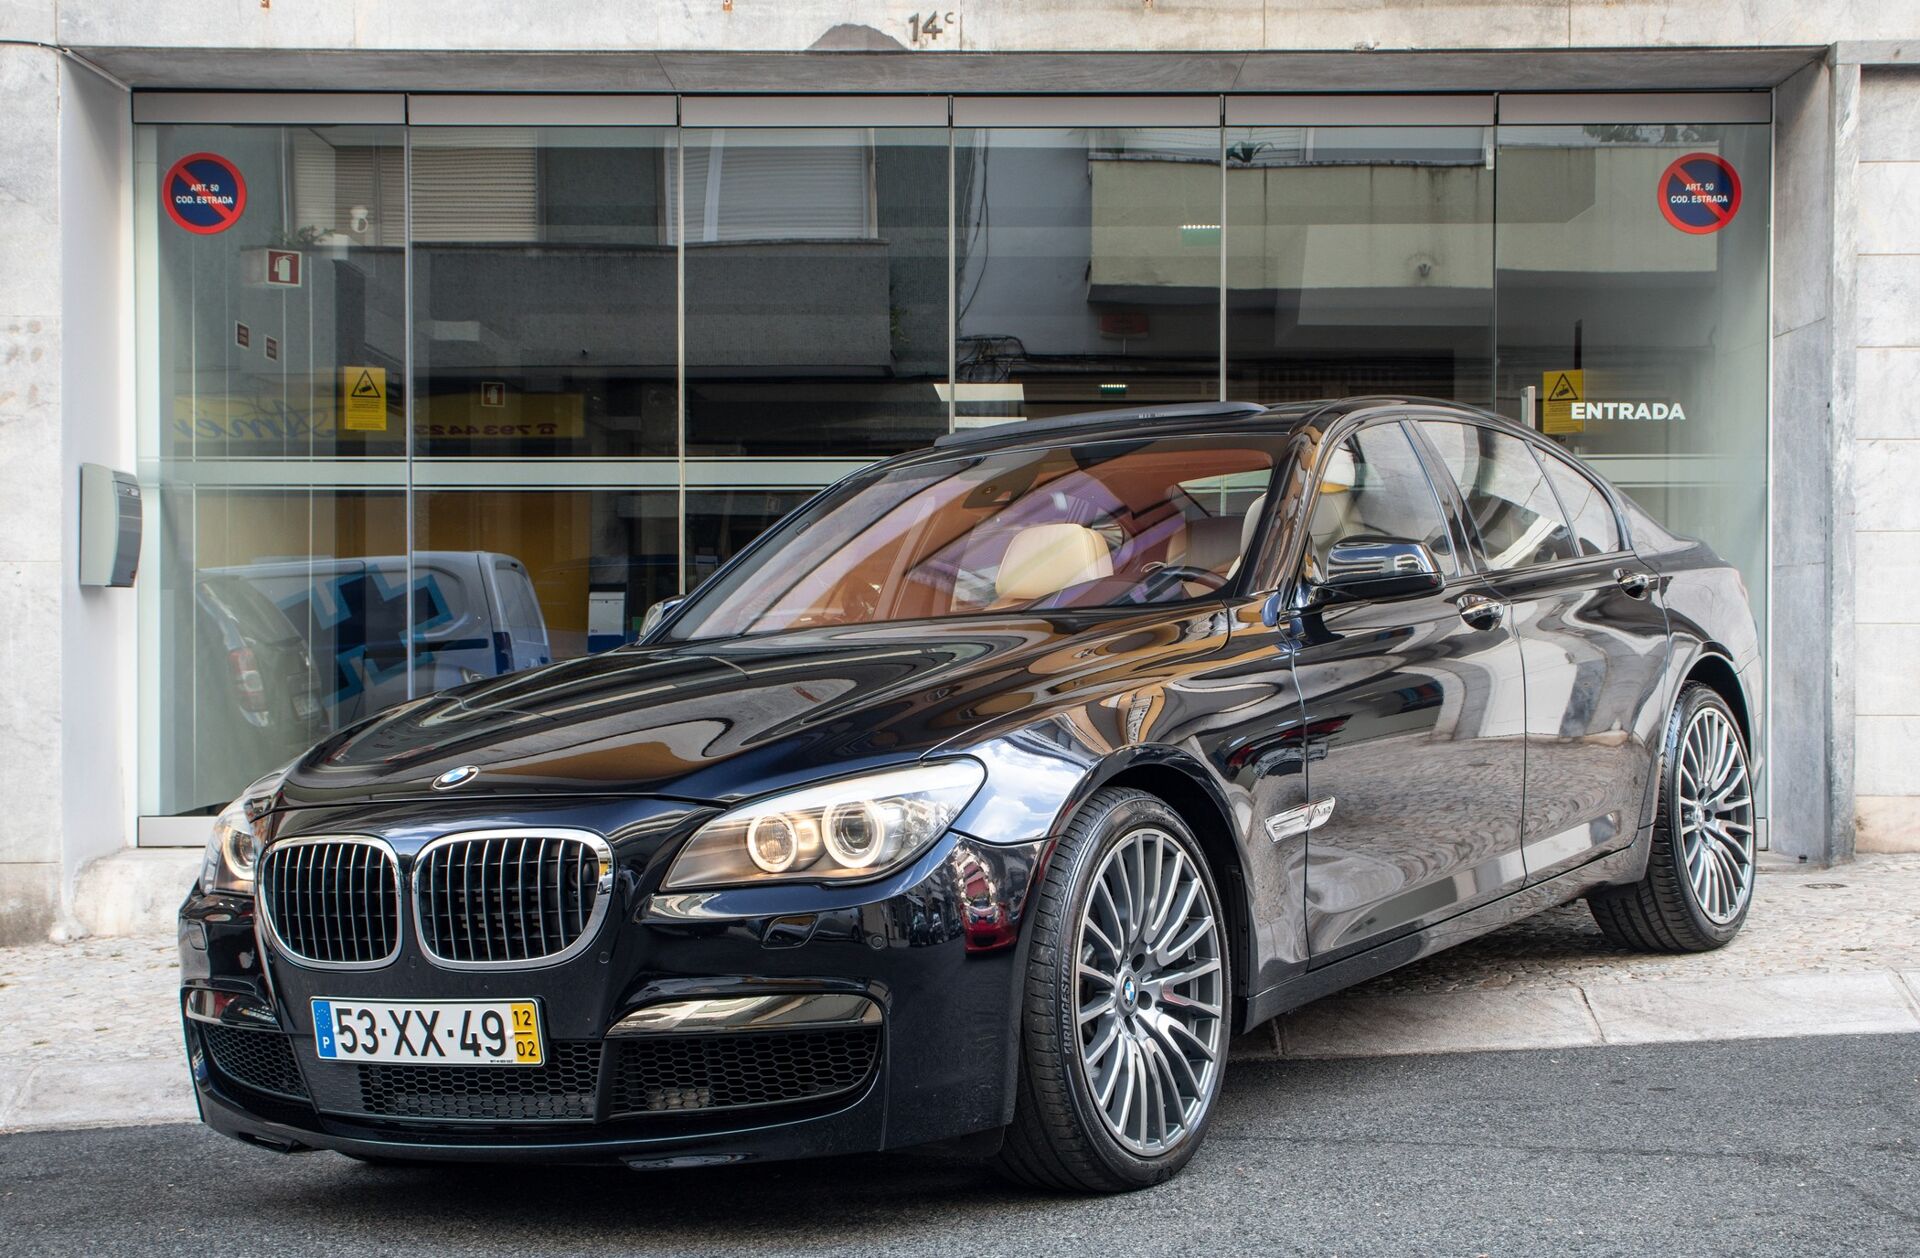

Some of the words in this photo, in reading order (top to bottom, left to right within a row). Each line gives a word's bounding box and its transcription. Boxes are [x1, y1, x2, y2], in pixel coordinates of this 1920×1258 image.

[190, 183, 209, 192] ART.
[210, 183, 220, 192] 50
[1685, 183, 1704, 191] ART.
[1705, 182, 1715, 191] 50
[175, 195, 195, 204] COD.
[196, 195, 233, 204] ESTRADA
[1670, 195, 1690, 204] COD.
[1691, 195, 1728, 204] ESTRADA
[1571, 402, 1686, 420] ENTRADA
[513, 1010, 532, 1026] 12
[322, 1036, 331, 1049] P
[516, 1040, 537, 1057] 02
